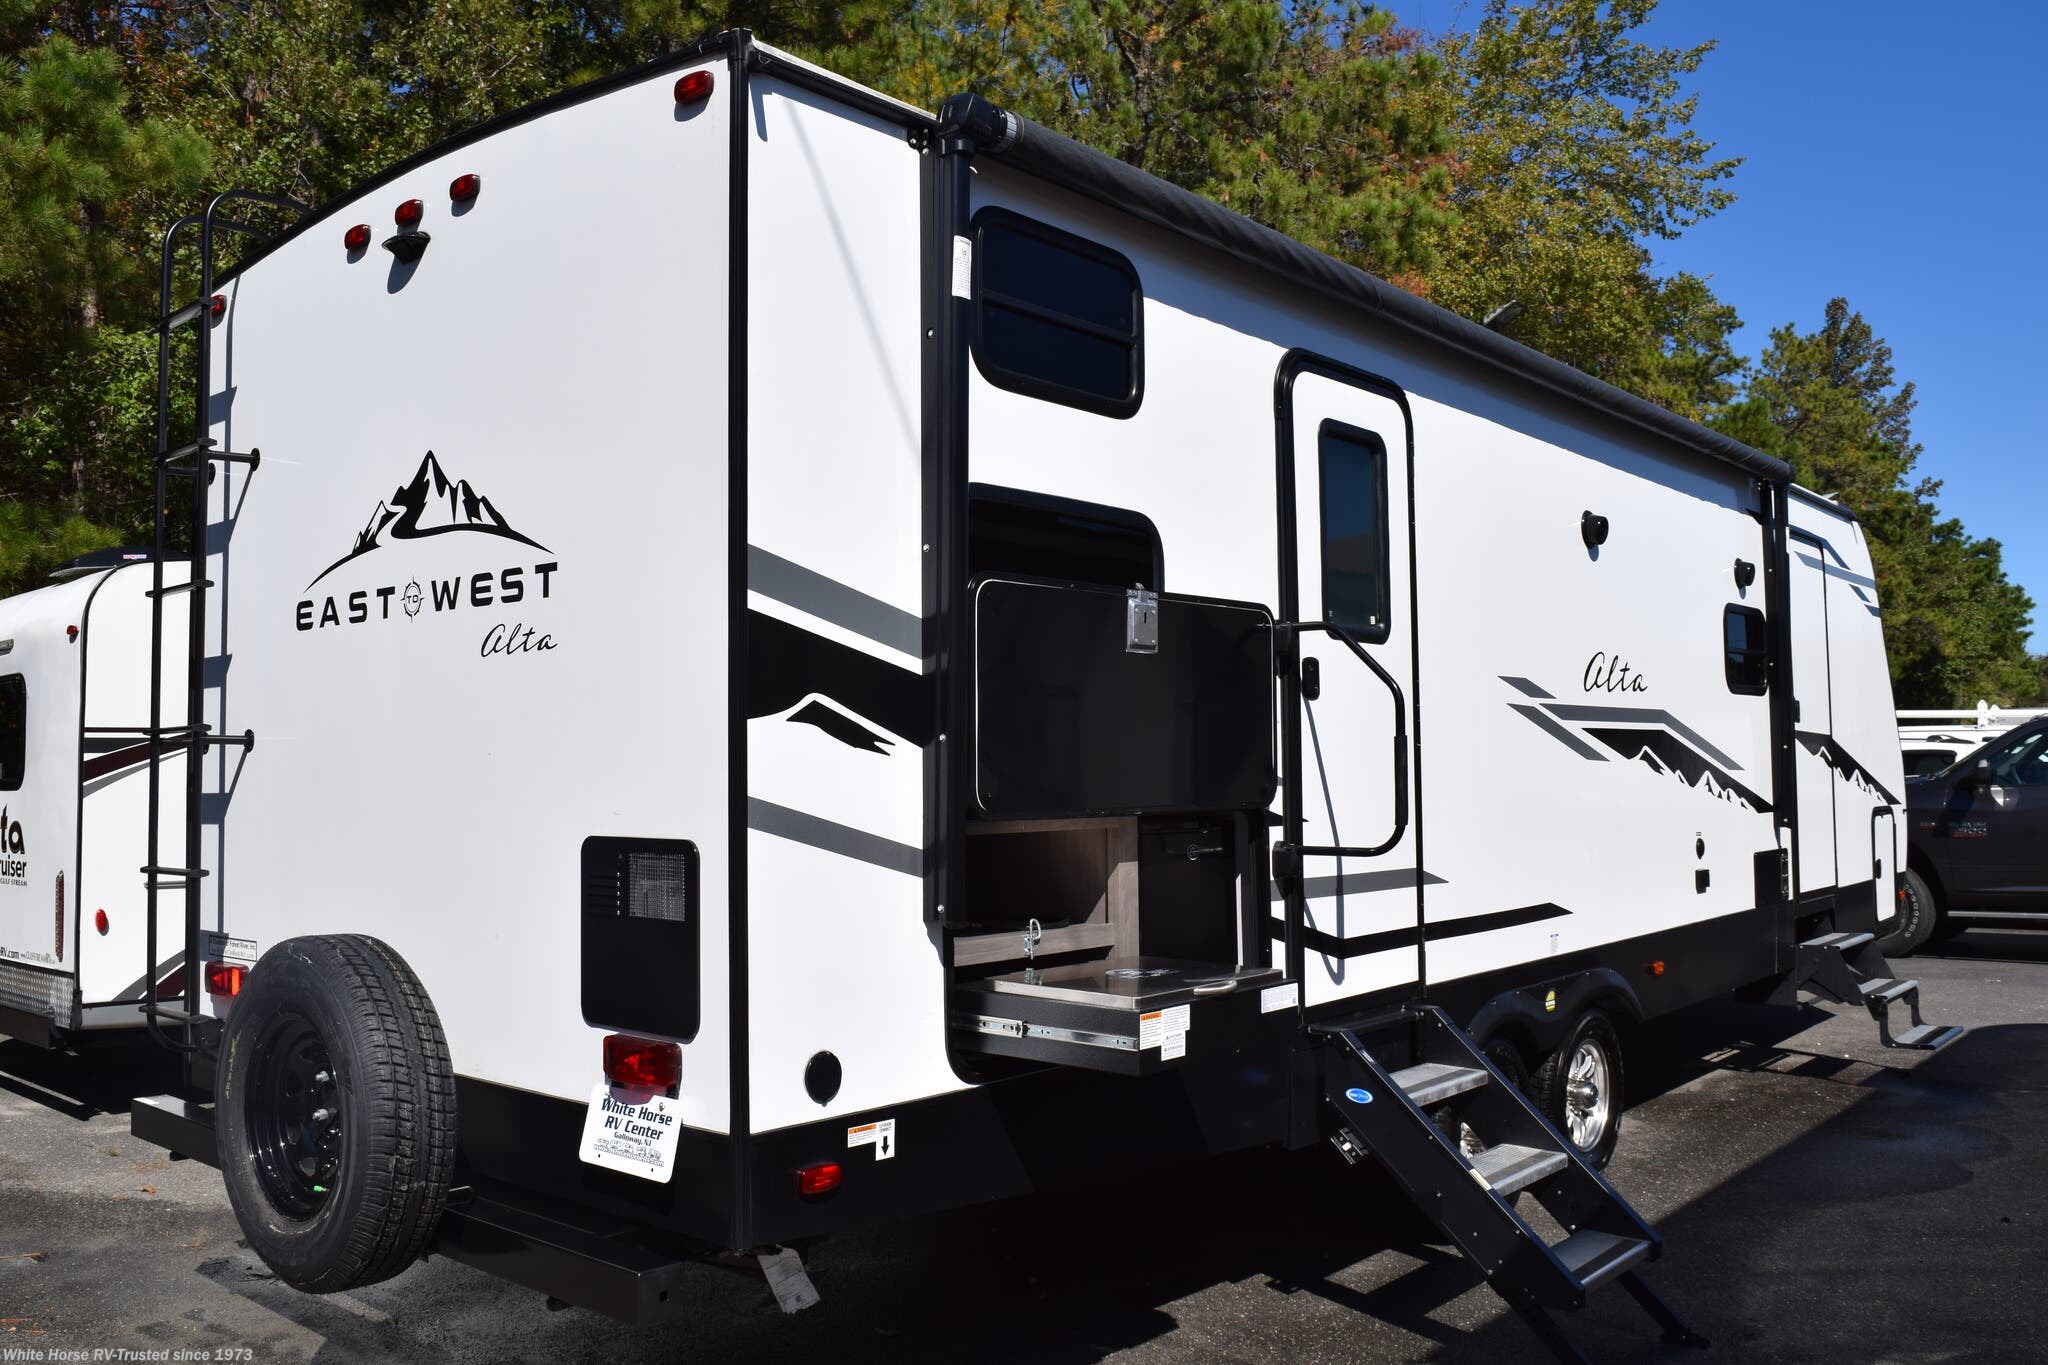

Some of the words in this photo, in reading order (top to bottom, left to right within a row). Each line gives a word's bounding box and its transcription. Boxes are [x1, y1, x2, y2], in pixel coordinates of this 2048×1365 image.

[296, 585, 396, 632] EAST
[406, 594, 419, 605] TO
[430, 561, 558, 612] WEST
[480, 622, 559, 658] Alta
[1582, 651, 1649, 693] Alta
[601, 1095, 636, 1118] White
[638, 1106, 673, 1126] Horse
[604, 1115, 624, 1131] RV
[625, 1120, 664, 1141] Center
